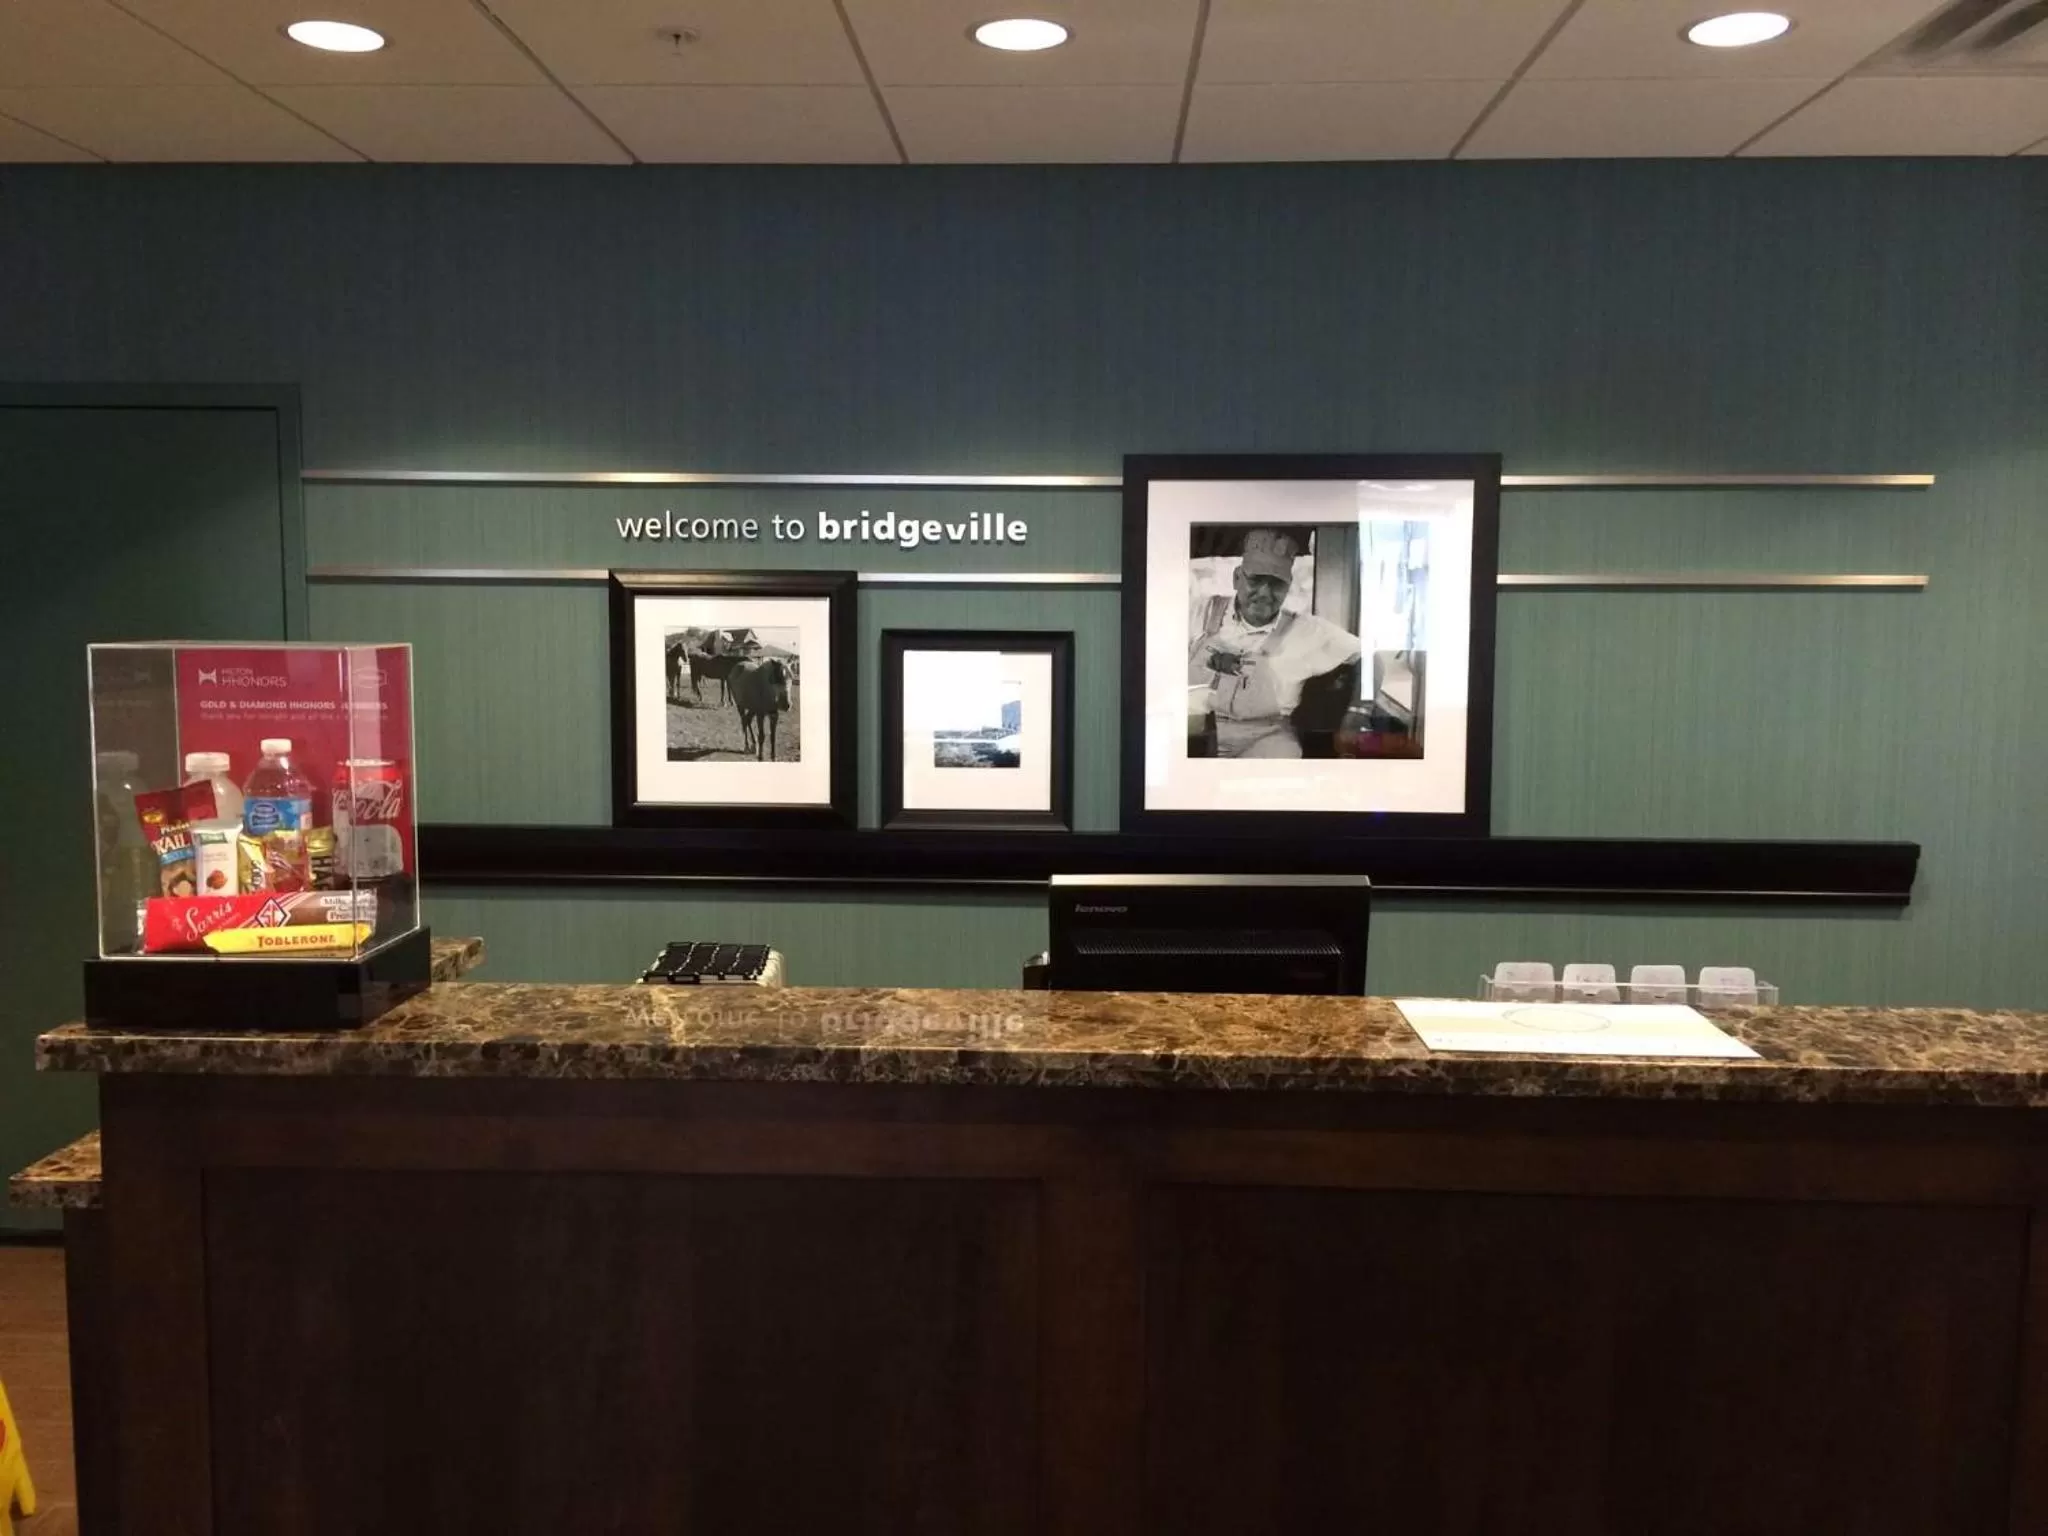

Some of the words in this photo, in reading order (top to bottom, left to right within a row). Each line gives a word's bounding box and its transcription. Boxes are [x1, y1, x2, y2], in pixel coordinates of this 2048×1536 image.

[616, 510, 759, 539] welcome
[771, 514, 805, 540] to
[818, 510, 1028, 548] bridgeville
[200, 701, 227, 709] GOLD
[240, 701, 287, 709] DIAMOND
[1074, 903, 1128, 913] lenovo
[257, 934, 336, 948] TOBLERONE
